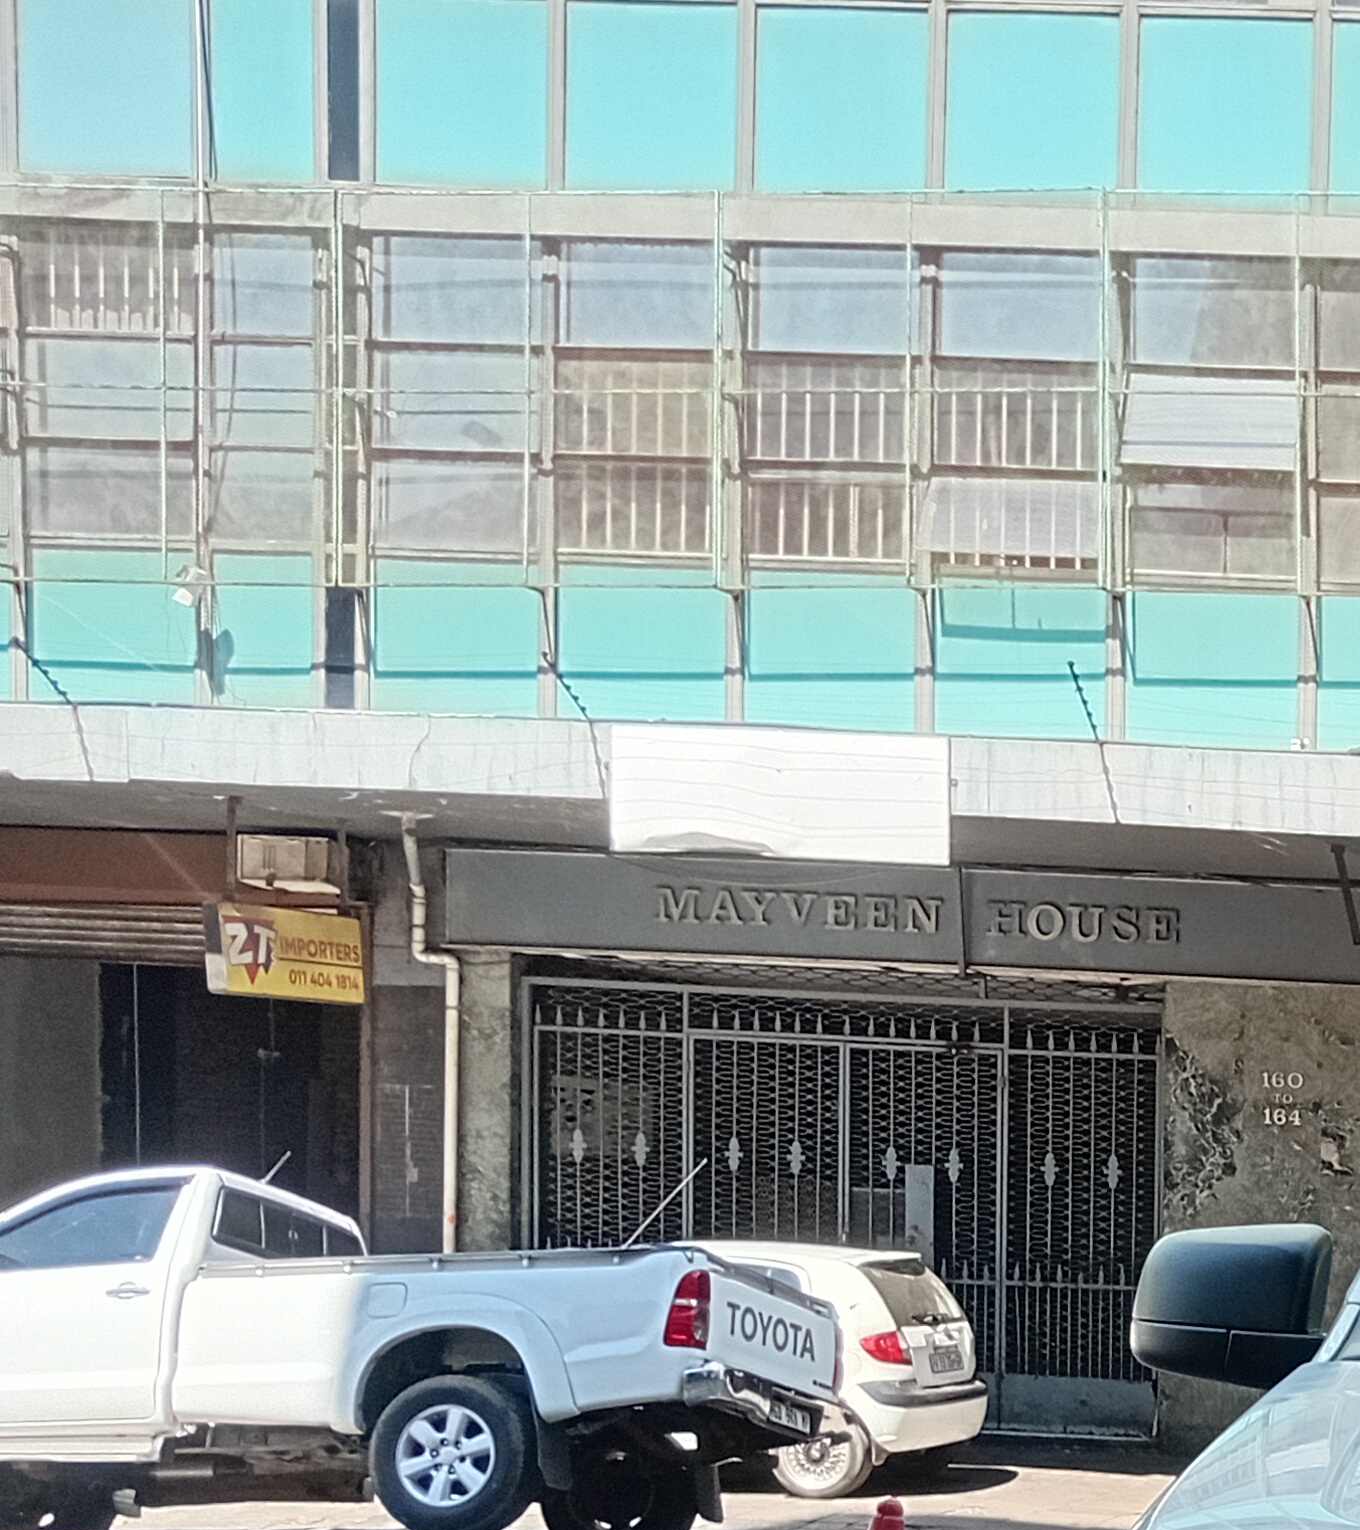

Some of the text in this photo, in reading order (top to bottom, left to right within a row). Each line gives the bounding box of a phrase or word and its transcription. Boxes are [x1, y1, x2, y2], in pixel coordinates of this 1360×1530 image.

[653, 885, 1182, 944] MAYVEEN HOUSE
[279, 935, 361, 963] IMPORTERS
[289, 968, 307, 985] 011
[310, 970, 333, 987] 404
[1262, 1071, 1304, 1089] 160
[1273, 1093, 1293, 1104] TO
[1263, 1107, 1302, 1126] 164
[726, 1301, 816, 1363] TOYOTA
